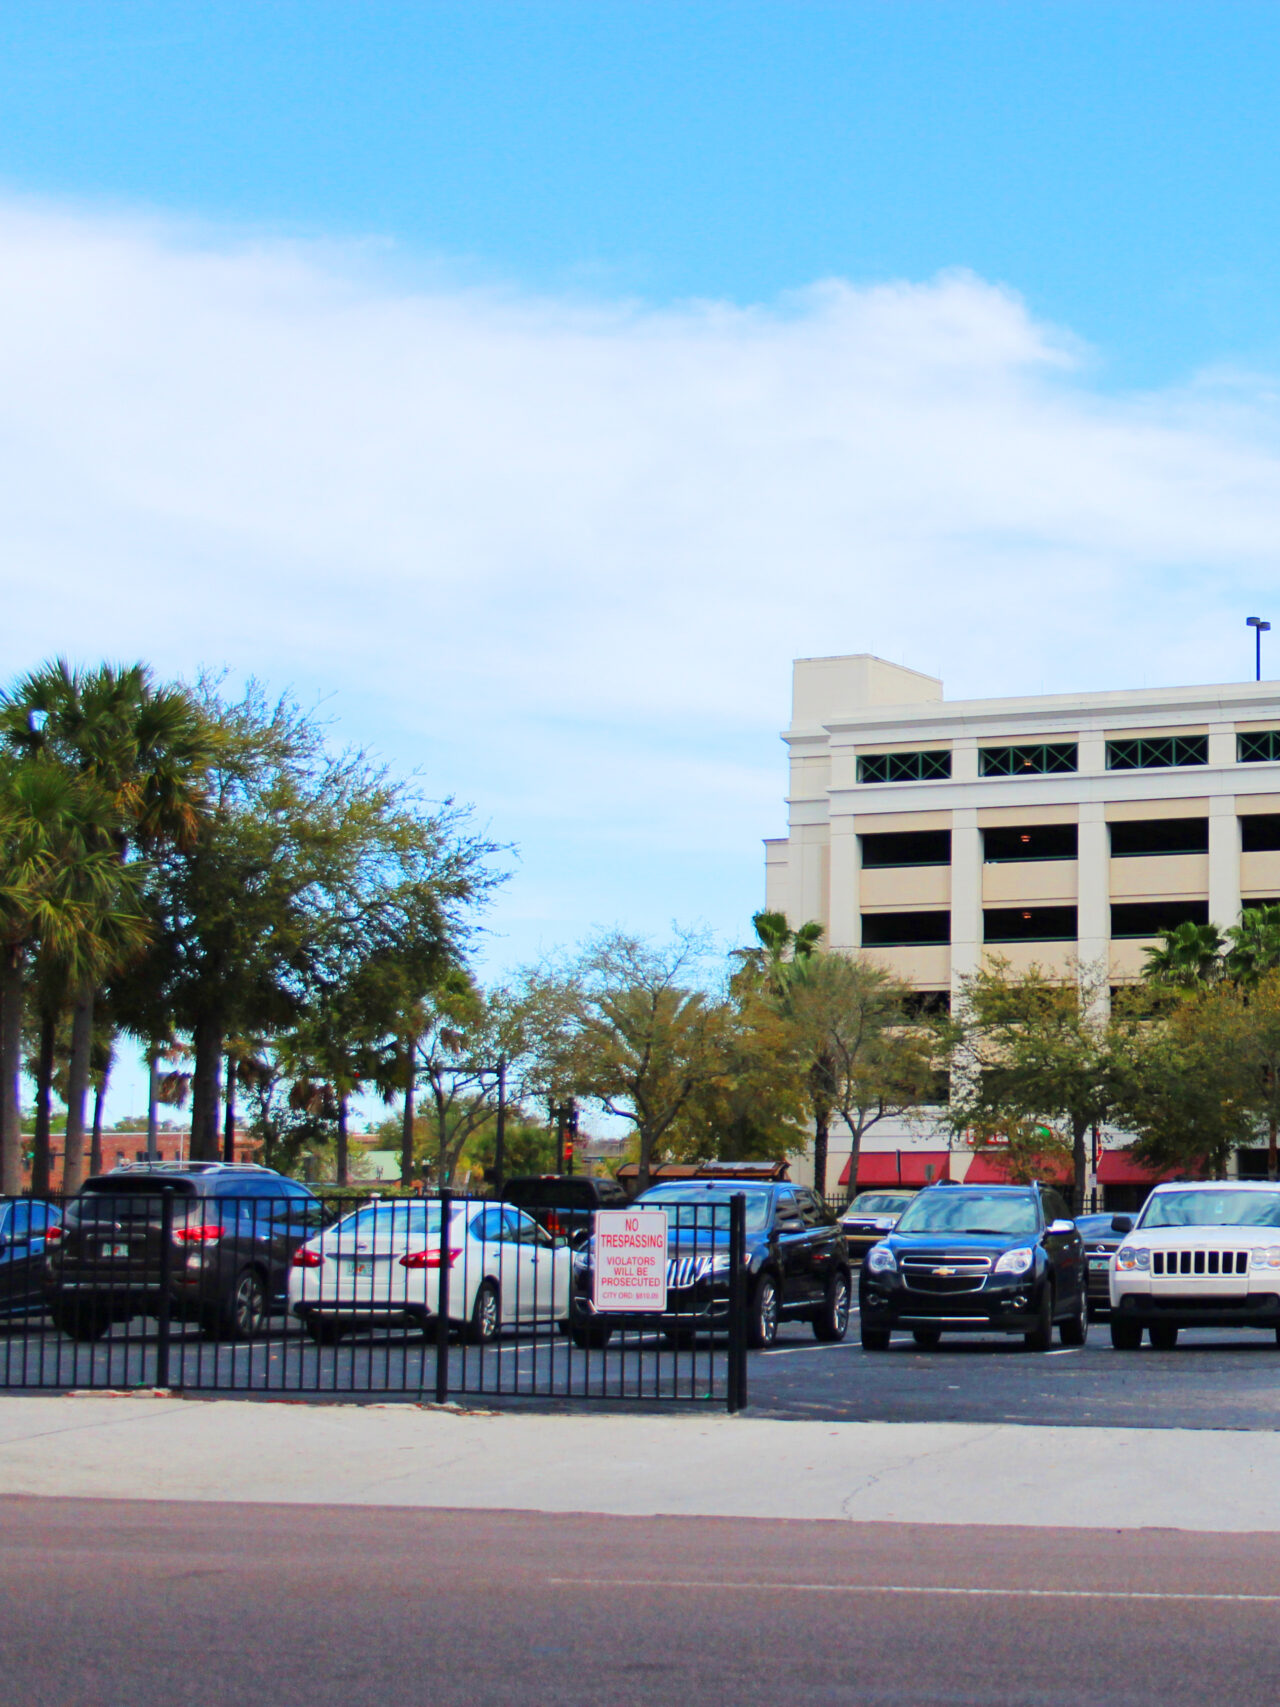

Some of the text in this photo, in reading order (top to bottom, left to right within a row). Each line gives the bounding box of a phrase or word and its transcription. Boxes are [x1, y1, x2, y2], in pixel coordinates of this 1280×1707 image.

[625, 1218, 639, 1232] NO
[601, 1234, 664, 1248] TRESPASSING
[606, 1256, 656, 1266] VIOLATORS
[614, 1267, 648, 1276] WILL BE
[601, 1277, 661, 1287] PROSECUTED
[602, 1291, 616, 1299] CITY
